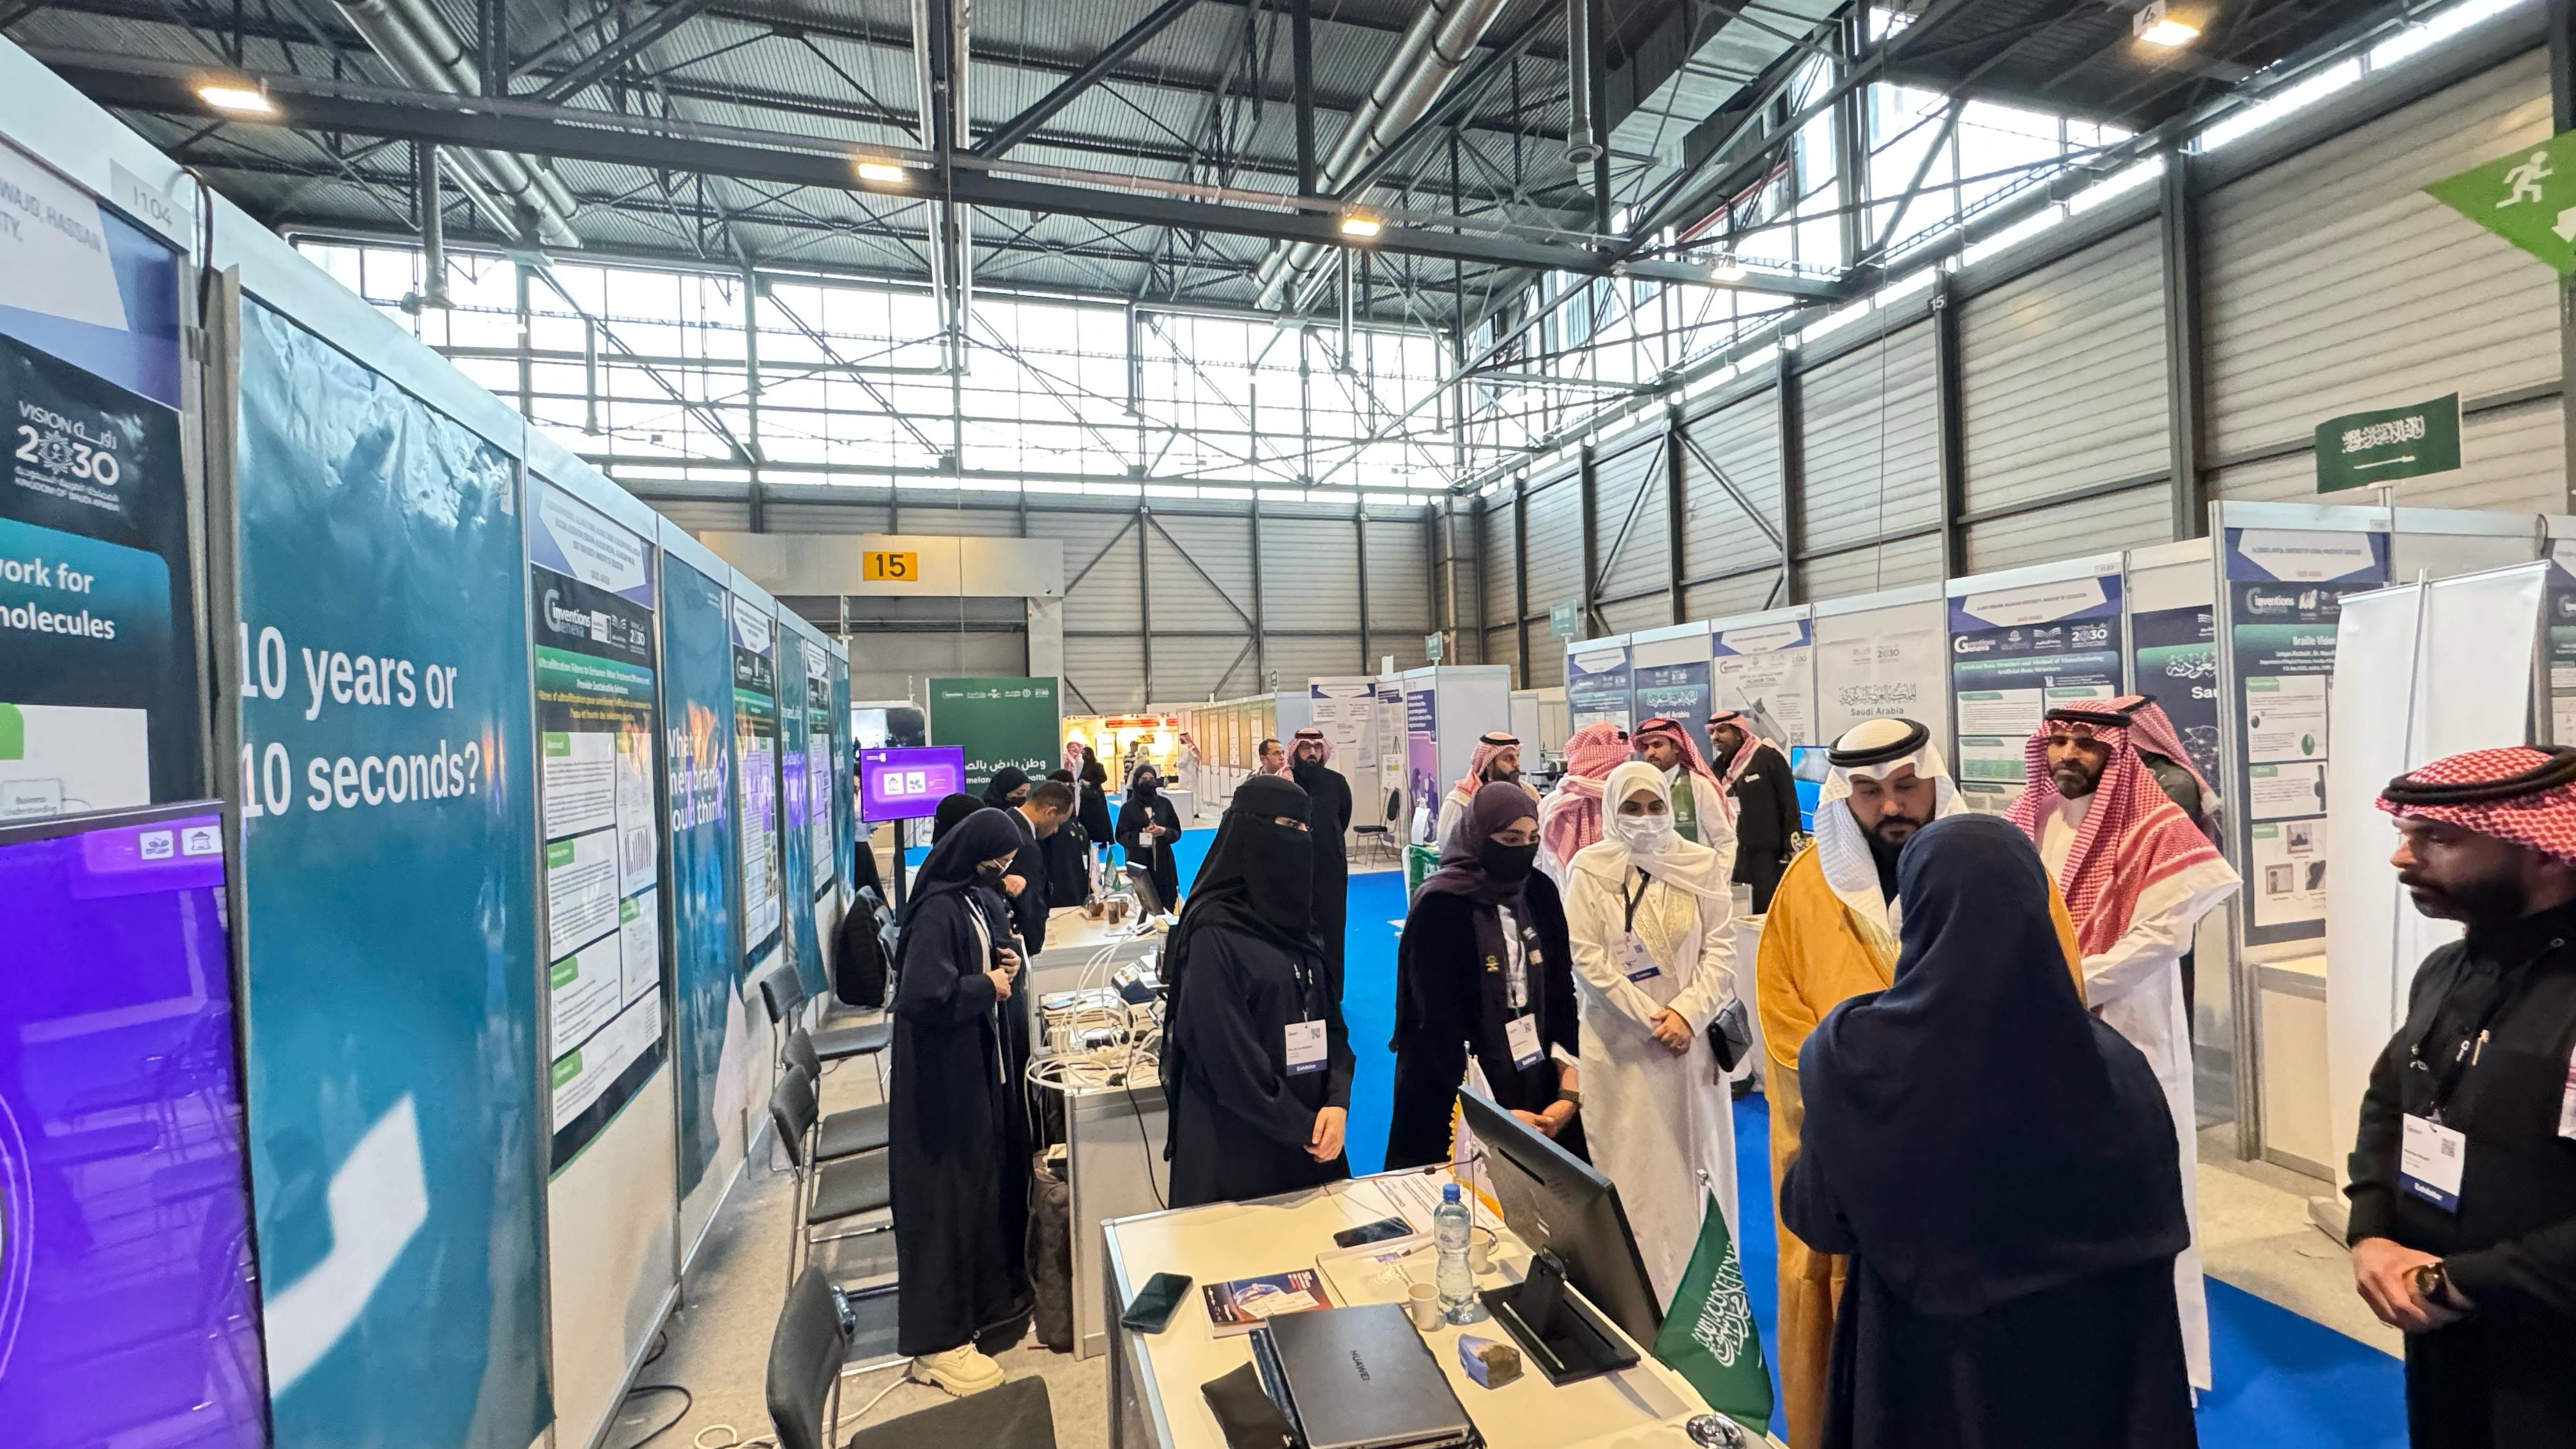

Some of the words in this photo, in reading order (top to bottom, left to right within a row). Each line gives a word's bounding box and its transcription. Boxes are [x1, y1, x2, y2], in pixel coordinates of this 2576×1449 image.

[19, 400, 72, 434] VISION
[0, 557, 51, 588] ork
[57, 563, 95, 594] for
[876, 553, 906, 578] 15
[552, 602, 591, 627] inventions
[240, 622, 287, 700] 10
[302, 647, 417, 721] years
[425, 664, 457, 709] or
[1850, 707, 1873, 716] Saudi
[1875, 706, 1904, 715] Arabia
[242, 742, 291, 818] 10
[307, 739, 480, 811] seconds?
[1022, 758, 1046, 772] وطن
[1349, 1349, 1370, 1381] HUAWEI
